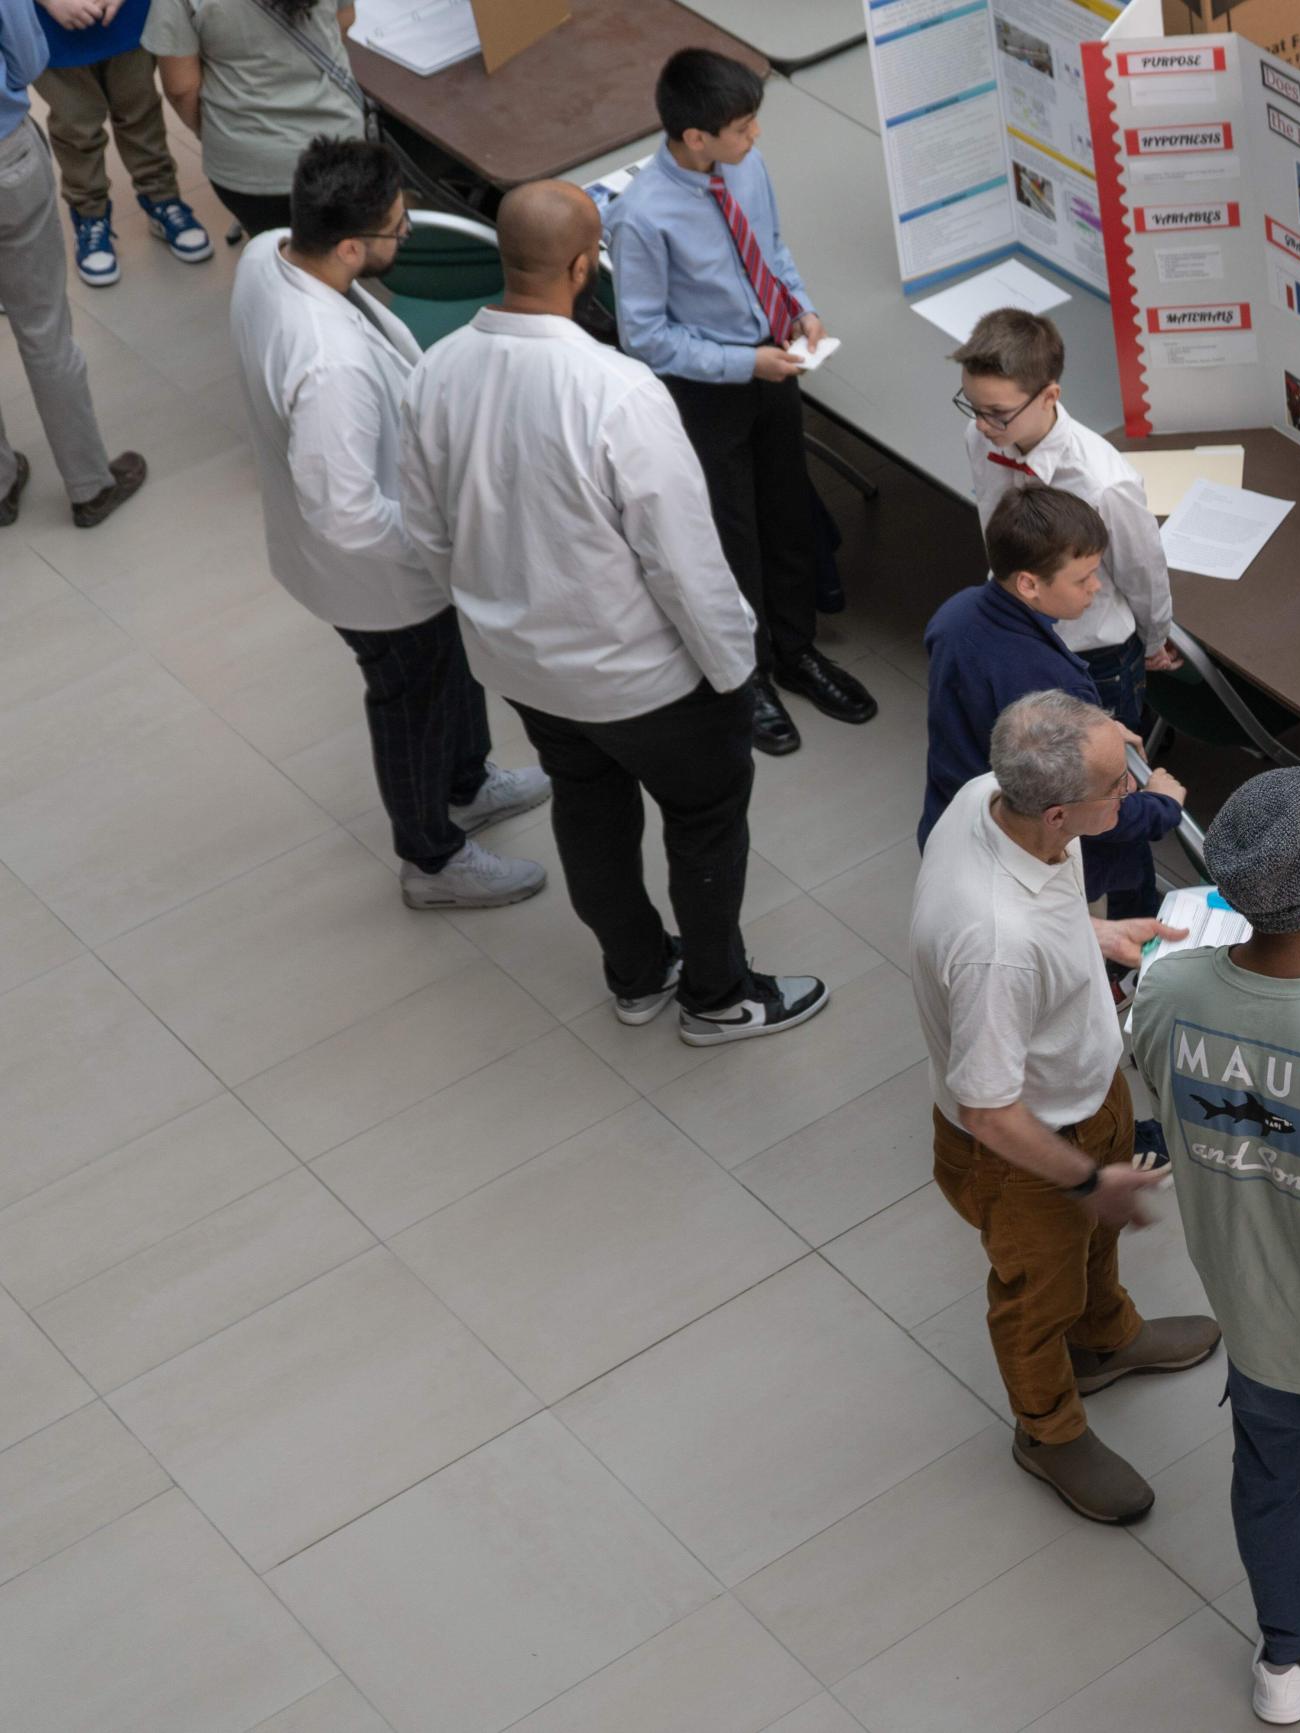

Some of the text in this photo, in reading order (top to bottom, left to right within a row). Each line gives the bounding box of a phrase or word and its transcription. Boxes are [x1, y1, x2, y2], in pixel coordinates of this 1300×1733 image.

[1142, 55, 1201, 68] PURPOSE
[1265, 68, 1298, 100] Does
[1271, 110, 1294, 138] the
[1142, 133, 1221, 148] HYPOTHESIS
[1152, 210, 1222, 225] VARIABLES
[1166, 310, 1234, 324] MATERIALS
[1192, 1141, 1254, 1171] and
